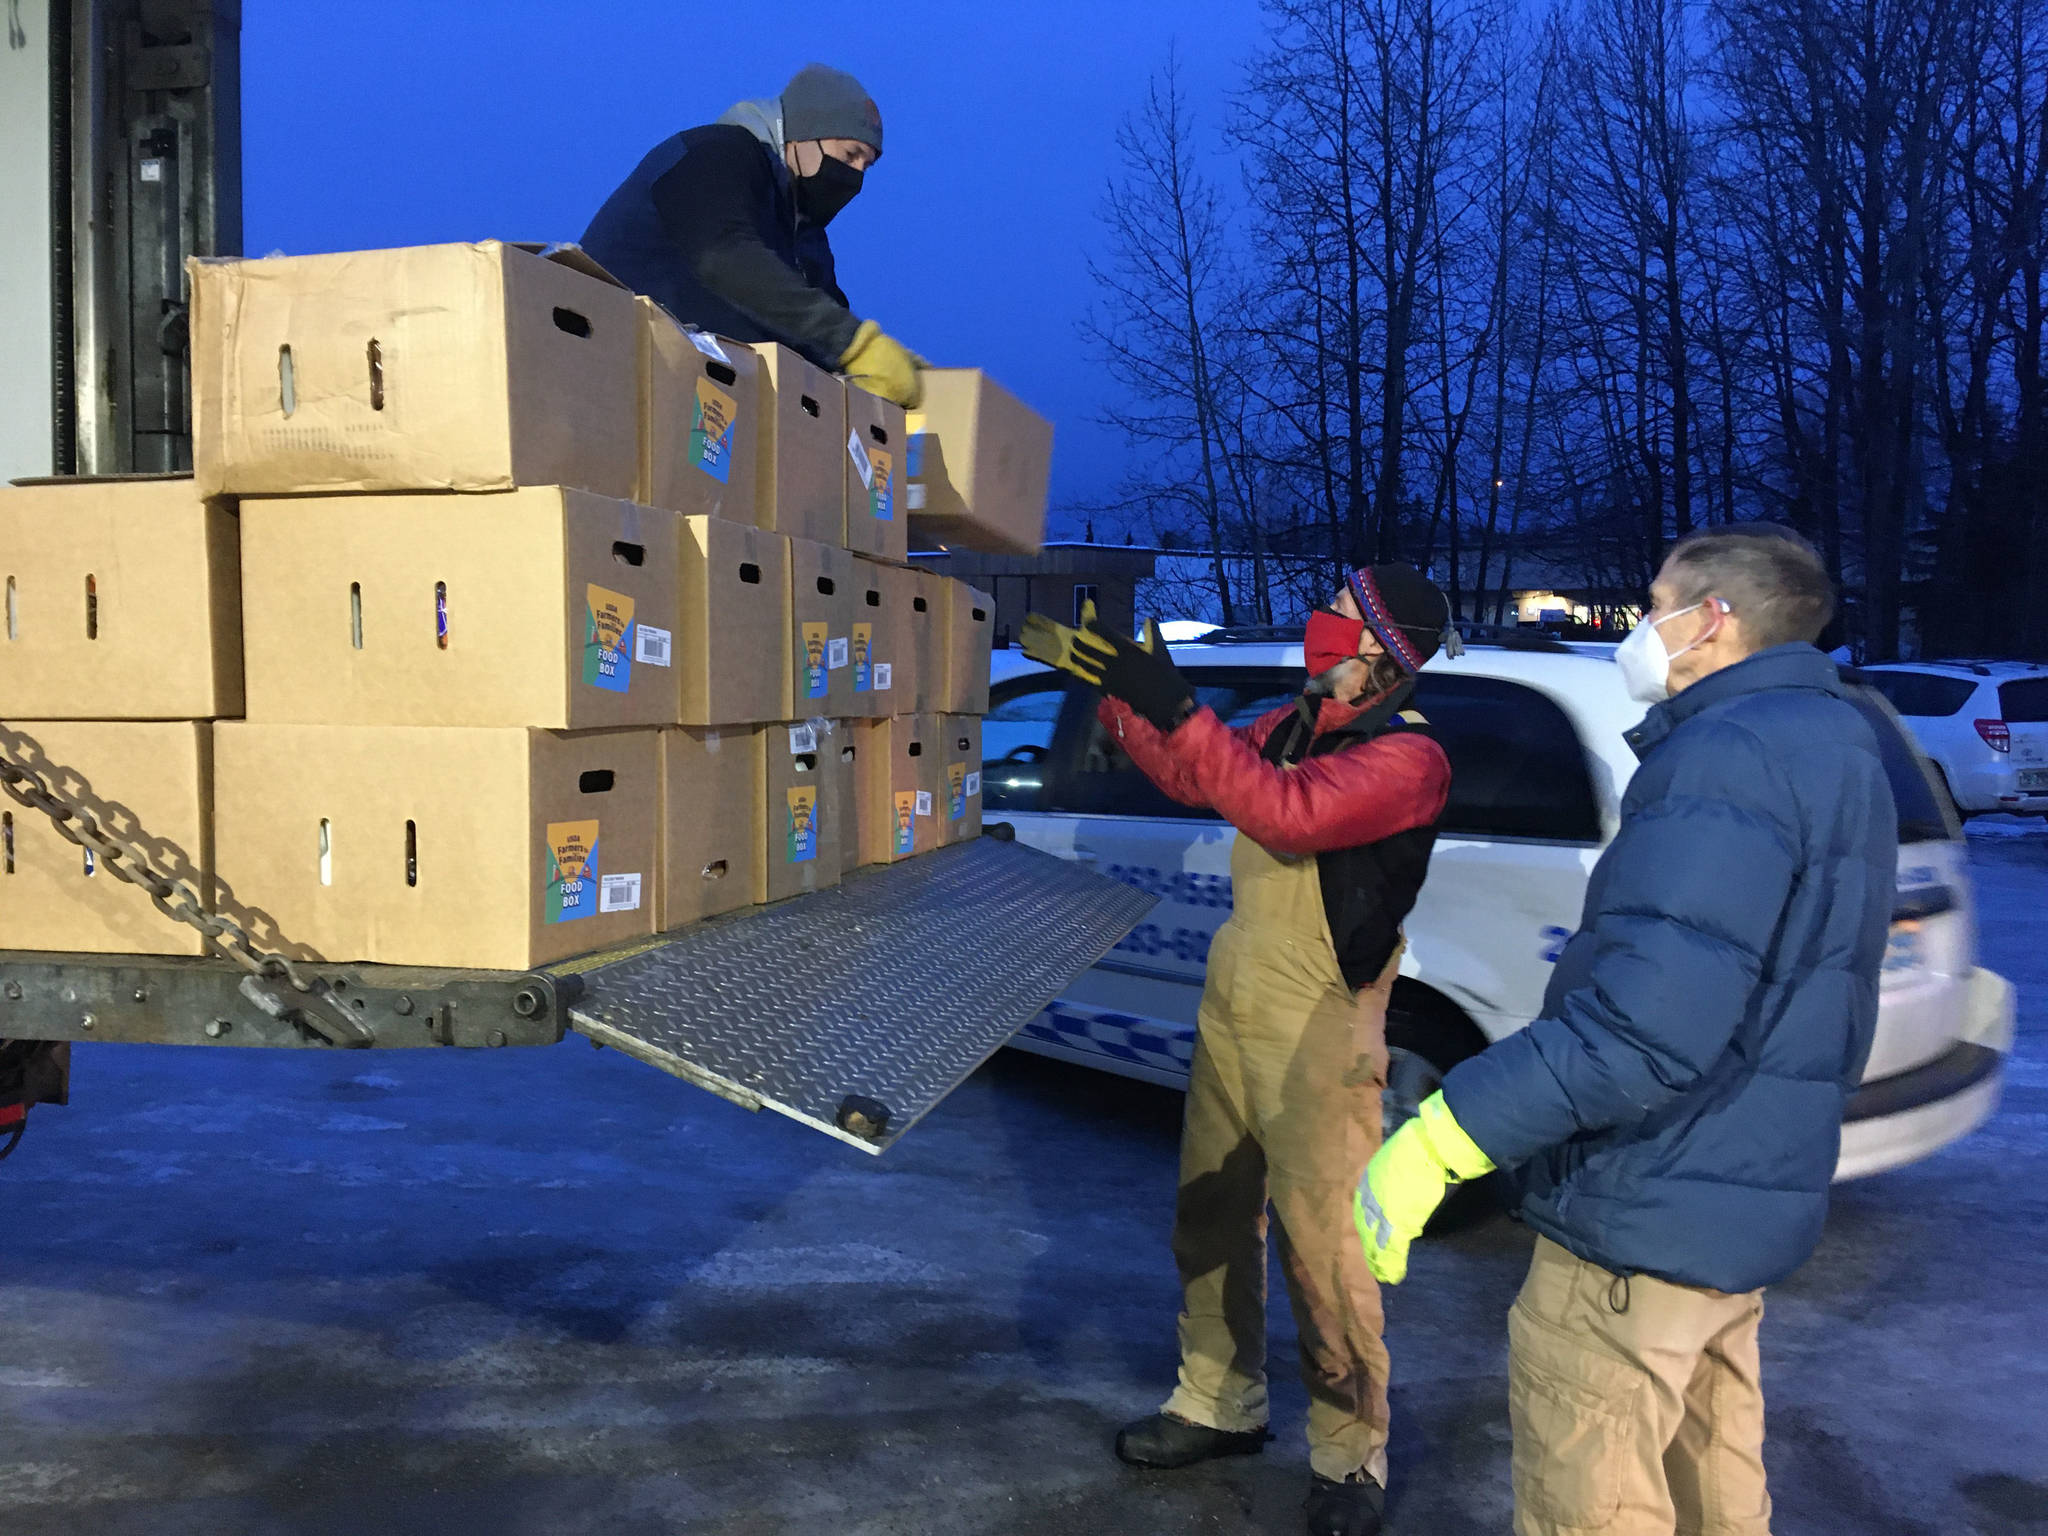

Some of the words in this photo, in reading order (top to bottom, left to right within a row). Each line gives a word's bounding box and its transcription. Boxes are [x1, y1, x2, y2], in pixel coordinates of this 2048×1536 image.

[703, 437, 721, 454] FOOD
[704, 449, 717, 465] BOX
[598, 649, 619, 664] FOOD
[600, 663, 616, 676] BOX
[558, 845, 583, 855] Farmers
[559, 855, 585, 865] Families
[561, 881, 583, 895] FOOD
[563, 895, 580, 907] BOX
